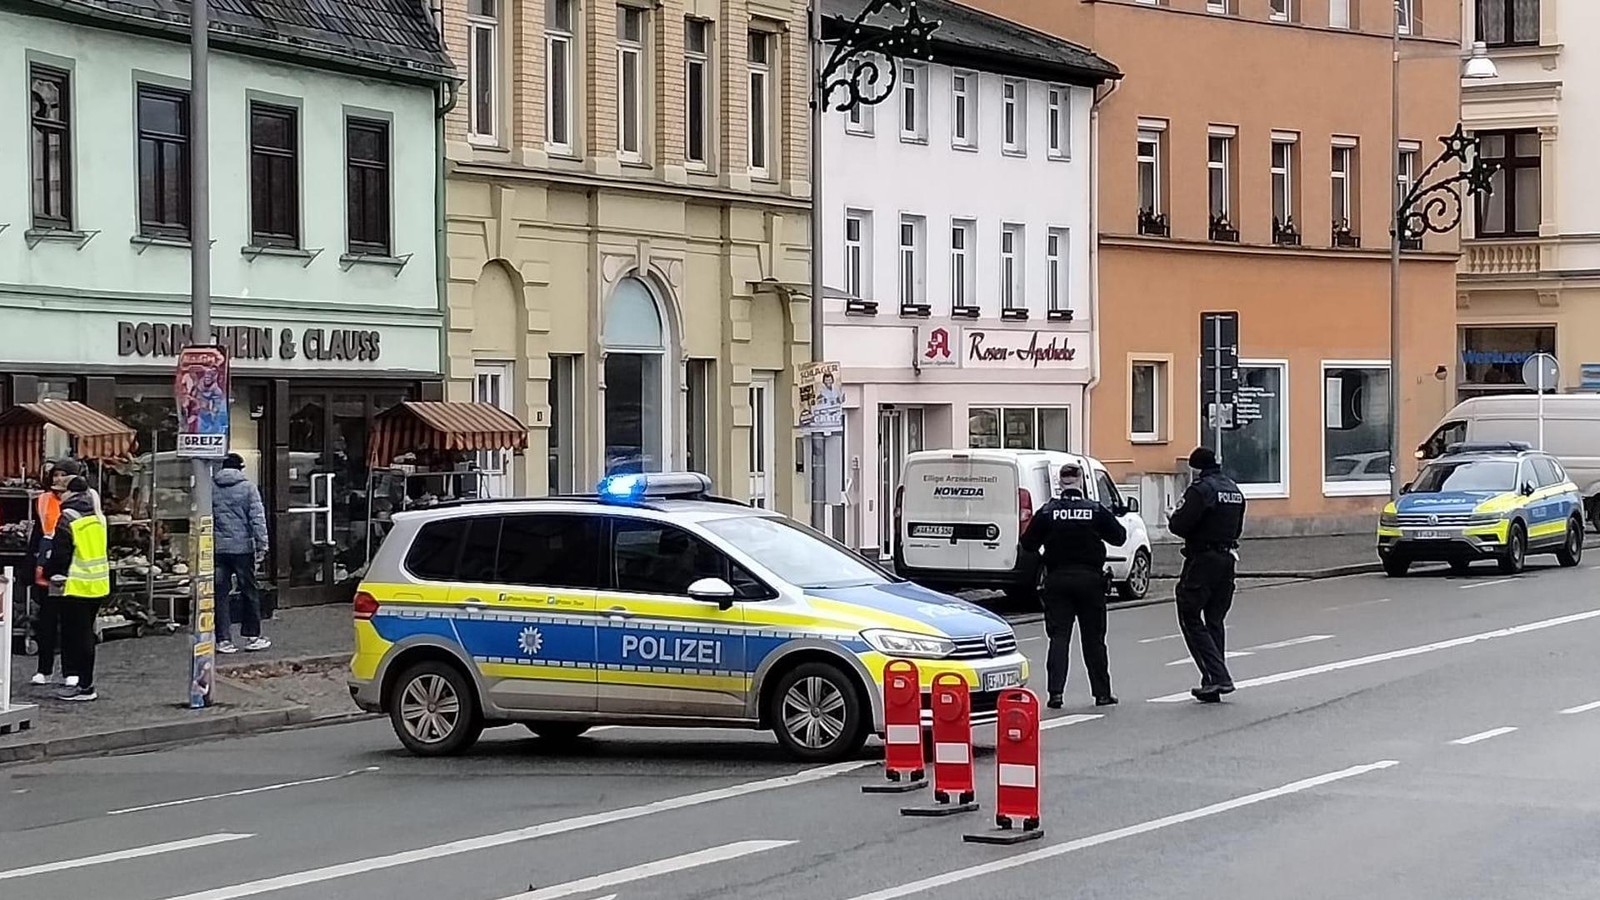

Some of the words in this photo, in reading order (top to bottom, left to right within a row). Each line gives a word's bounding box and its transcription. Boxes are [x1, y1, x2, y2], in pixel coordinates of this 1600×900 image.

[279, 328, 297, 359] &
[303, 329, 380, 361] CLAUSS
[184, 436, 223, 446] GREIZ
[933, 486, 984, 496] NOWEDA
[1053, 509, 1093, 520] POLIZEI
[622, 635, 721, 664] POLIZEI
